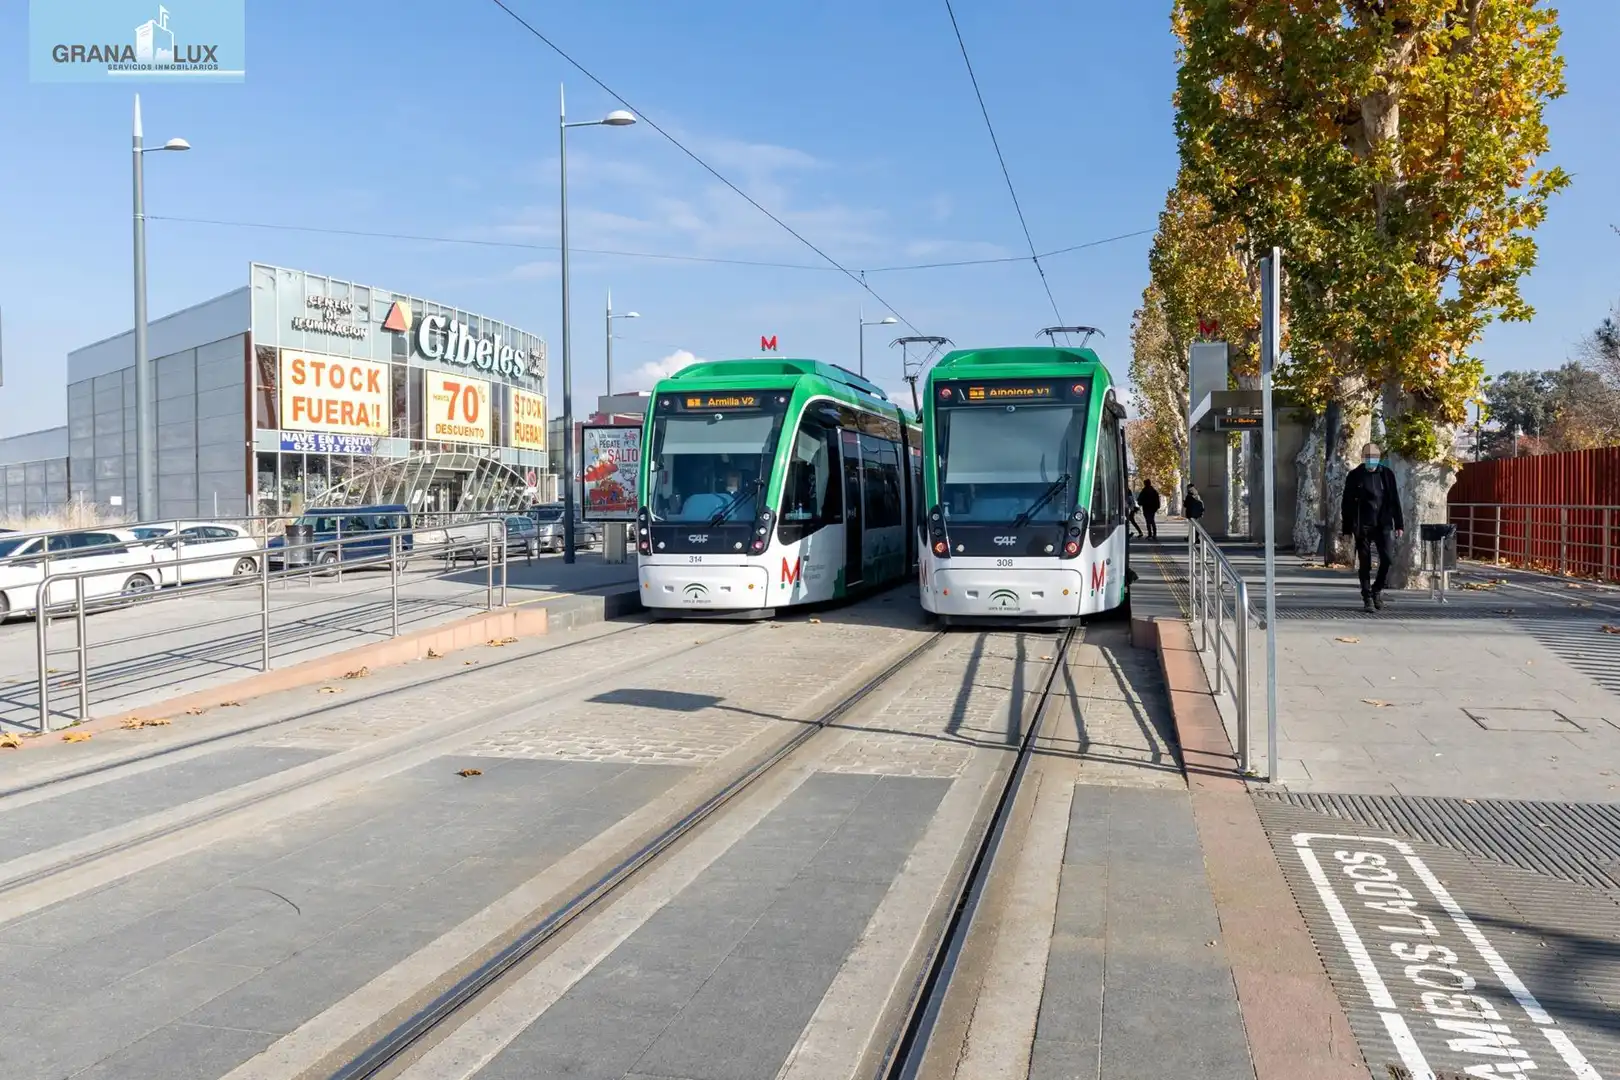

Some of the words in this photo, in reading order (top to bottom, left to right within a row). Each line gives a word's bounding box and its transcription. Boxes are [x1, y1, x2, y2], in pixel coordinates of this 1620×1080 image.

[1199, 319, 1218, 338] M
[419, 314, 526, 377] Cibeles
[761, 335, 777, 352] M
[291, 358, 381, 394] STOCK
[514, 394, 542, 419] STOCK
[708, 397, 740, 406] Armilla
[741, 396, 754, 405] V2
[292, 396, 381, 428] FUERA!!
[281, 432, 315, 442] NAVE
[318, 434, 335, 444] EN
[337, 435, 371, 446] VENTA
[435, 423, 485, 439] DESCUENTO
[294, 442, 316, 451] 622
[608, 448, 639, 463] SALTO
[688, 534, 709, 543] CAF
[993, 536, 1017, 546] CAF
[688, 555, 702, 564] 314
[996, 558, 1014, 567] 308
[781, 556, 801, 587] M
[1091, 560, 1105, 593] M
[1334, 850, 1441, 937] LADOS
